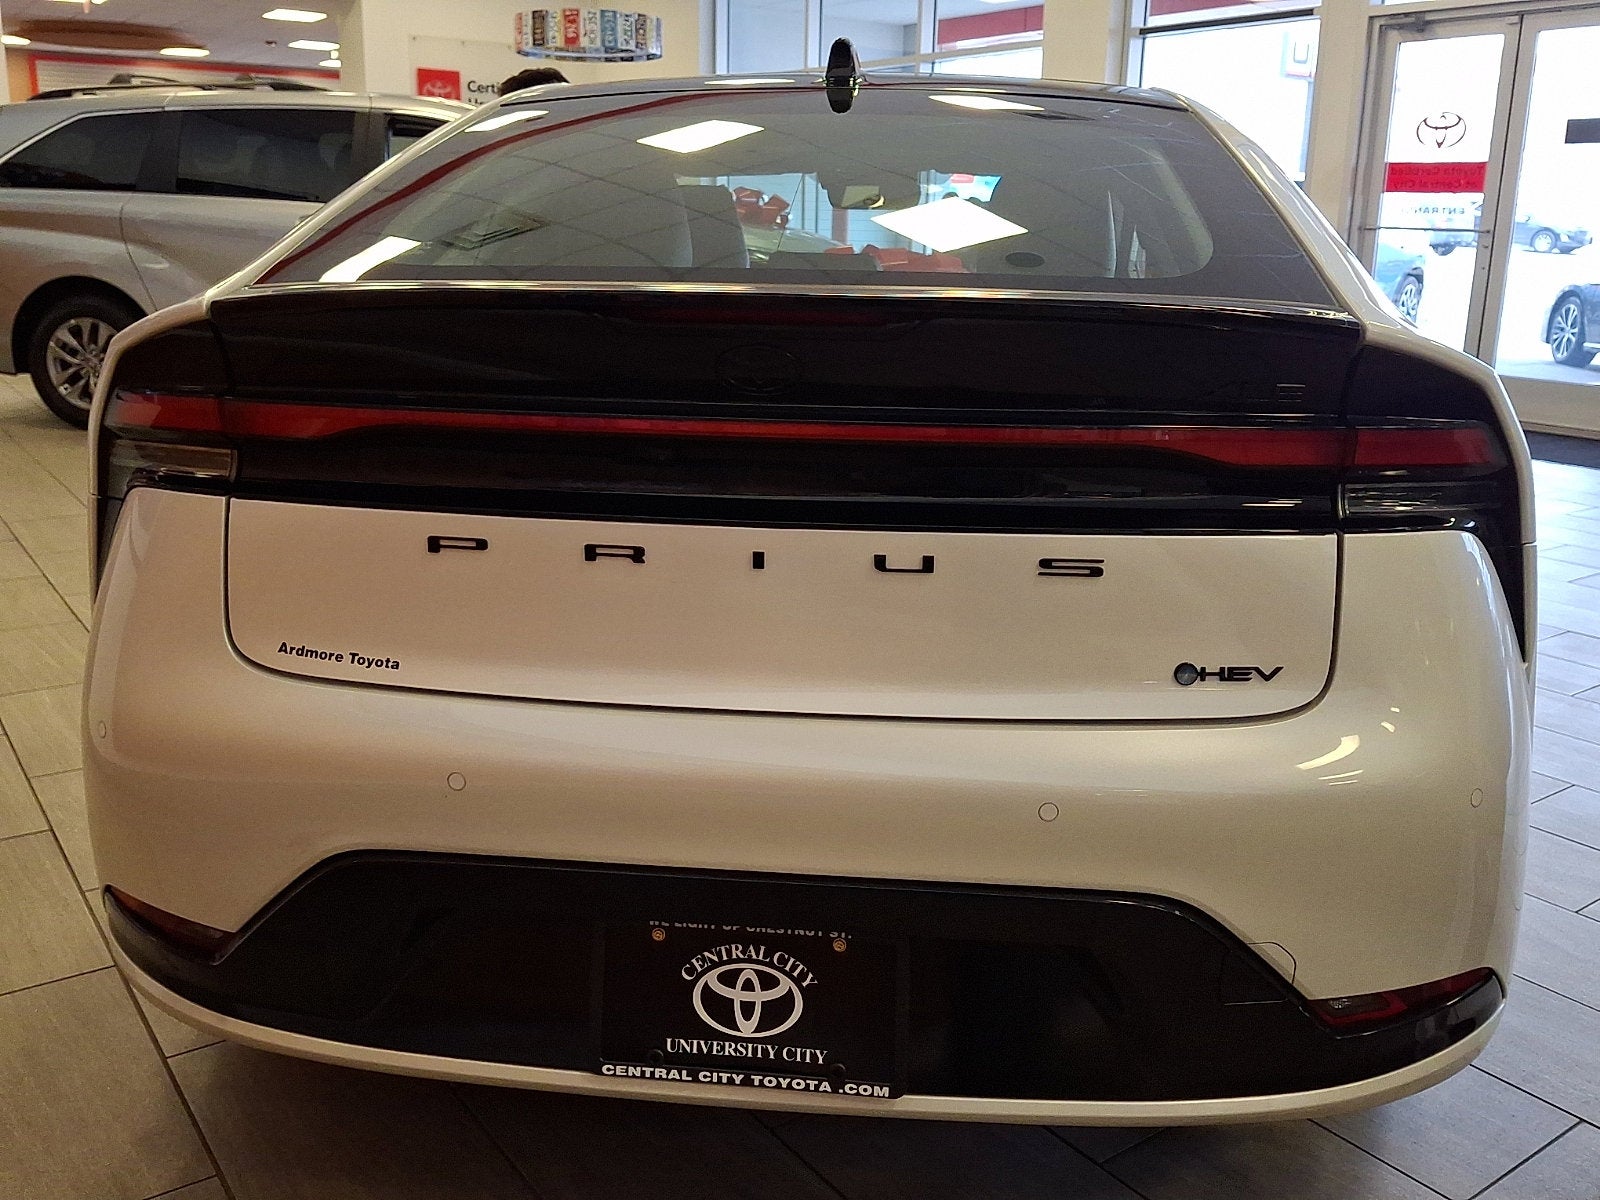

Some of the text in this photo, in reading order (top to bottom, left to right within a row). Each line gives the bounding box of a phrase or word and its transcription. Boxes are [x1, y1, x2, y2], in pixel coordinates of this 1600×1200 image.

[426, 535, 1105, 578] PRIUS
[277, 641, 401, 670] Ardmore Toyota
[681, 943, 818, 988] CENTRAL CITY
[665, 1037, 828, 1065] UNIVERSITY CITY
[601, 1064, 890, 1098] CENTRAL CITY TOYOTA .COM
